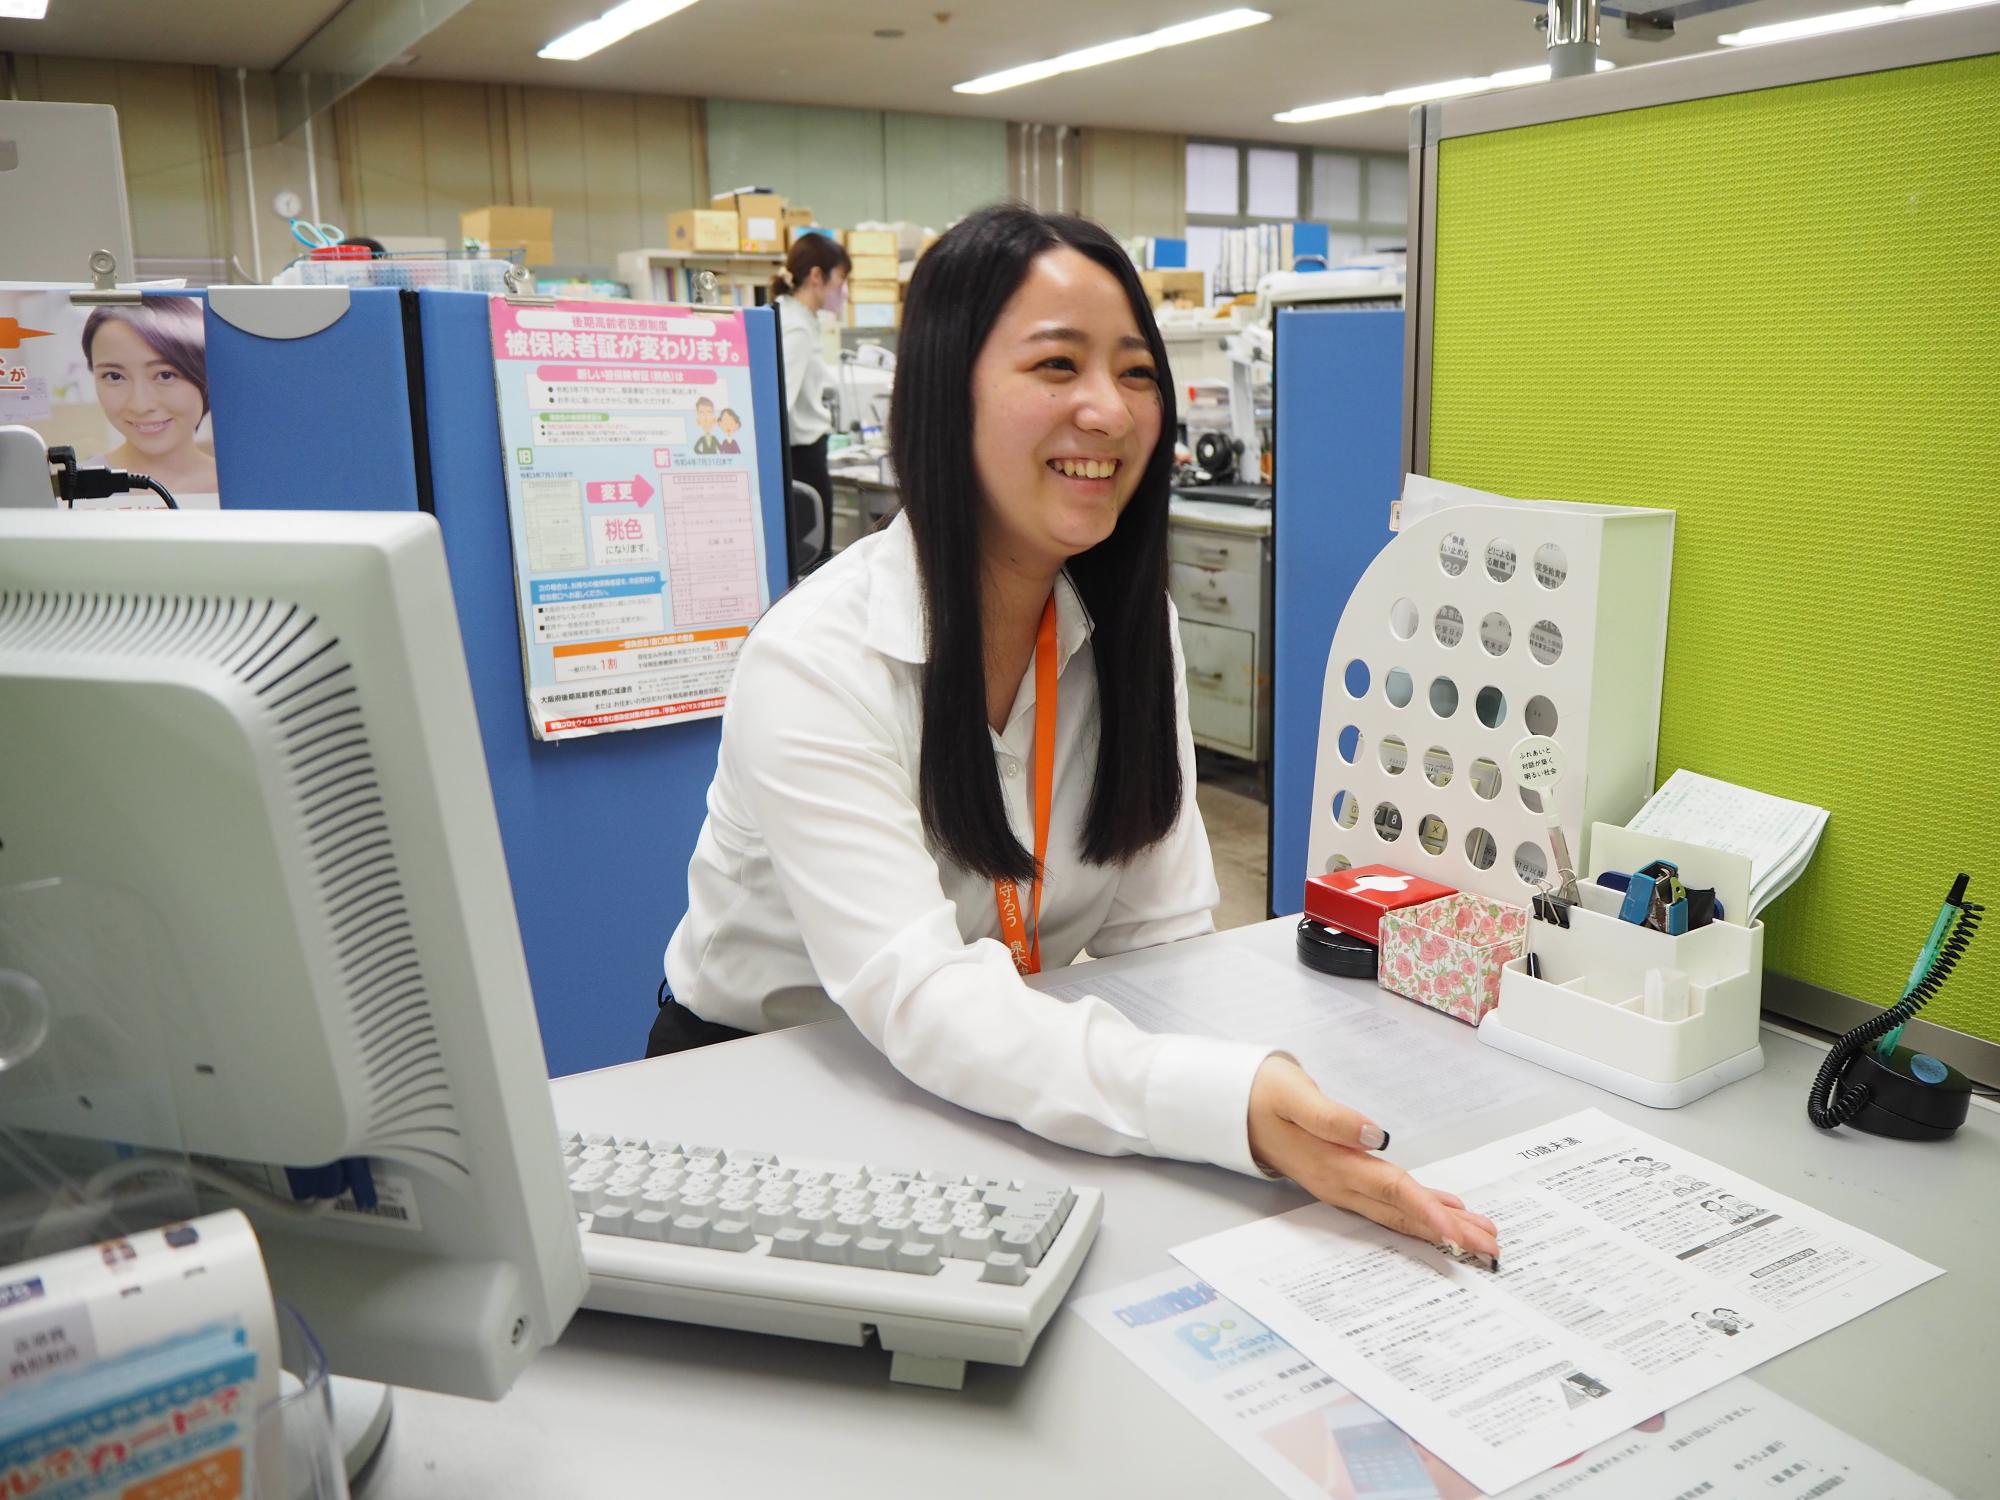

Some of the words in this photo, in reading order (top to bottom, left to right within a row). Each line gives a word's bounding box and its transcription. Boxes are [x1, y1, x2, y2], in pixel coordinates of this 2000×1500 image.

[571, 315, 669, 332] 後期高齢者医療制度
[504, 329, 740, 363] 被保険者証が変わります。
[518, 449, 532, 464] 旧
[656, 450, 670, 467] 新
[600, 482, 634, 501] 変更
[604, 518, 643, 542] 桃色
[605, 544, 650, 554] になります。
[713, 639, 729, 653] 3割
[600, 657, 618, 671] 1割
[540, 685, 633, 704] 大阪府後期高齢者医療広域連合
[1519, 746, 1552, 760] ふれあいと
[1521, 757, 1553, 770] 対話が築く
[1524, 767, 1557, 781] 明るい社会
[1391, 814, 1398, 825] 8
[1515, 1136, 1583, 1160] 70歳未満
[1733, 1439, 1788, 1471] ゆうちょ銀行
